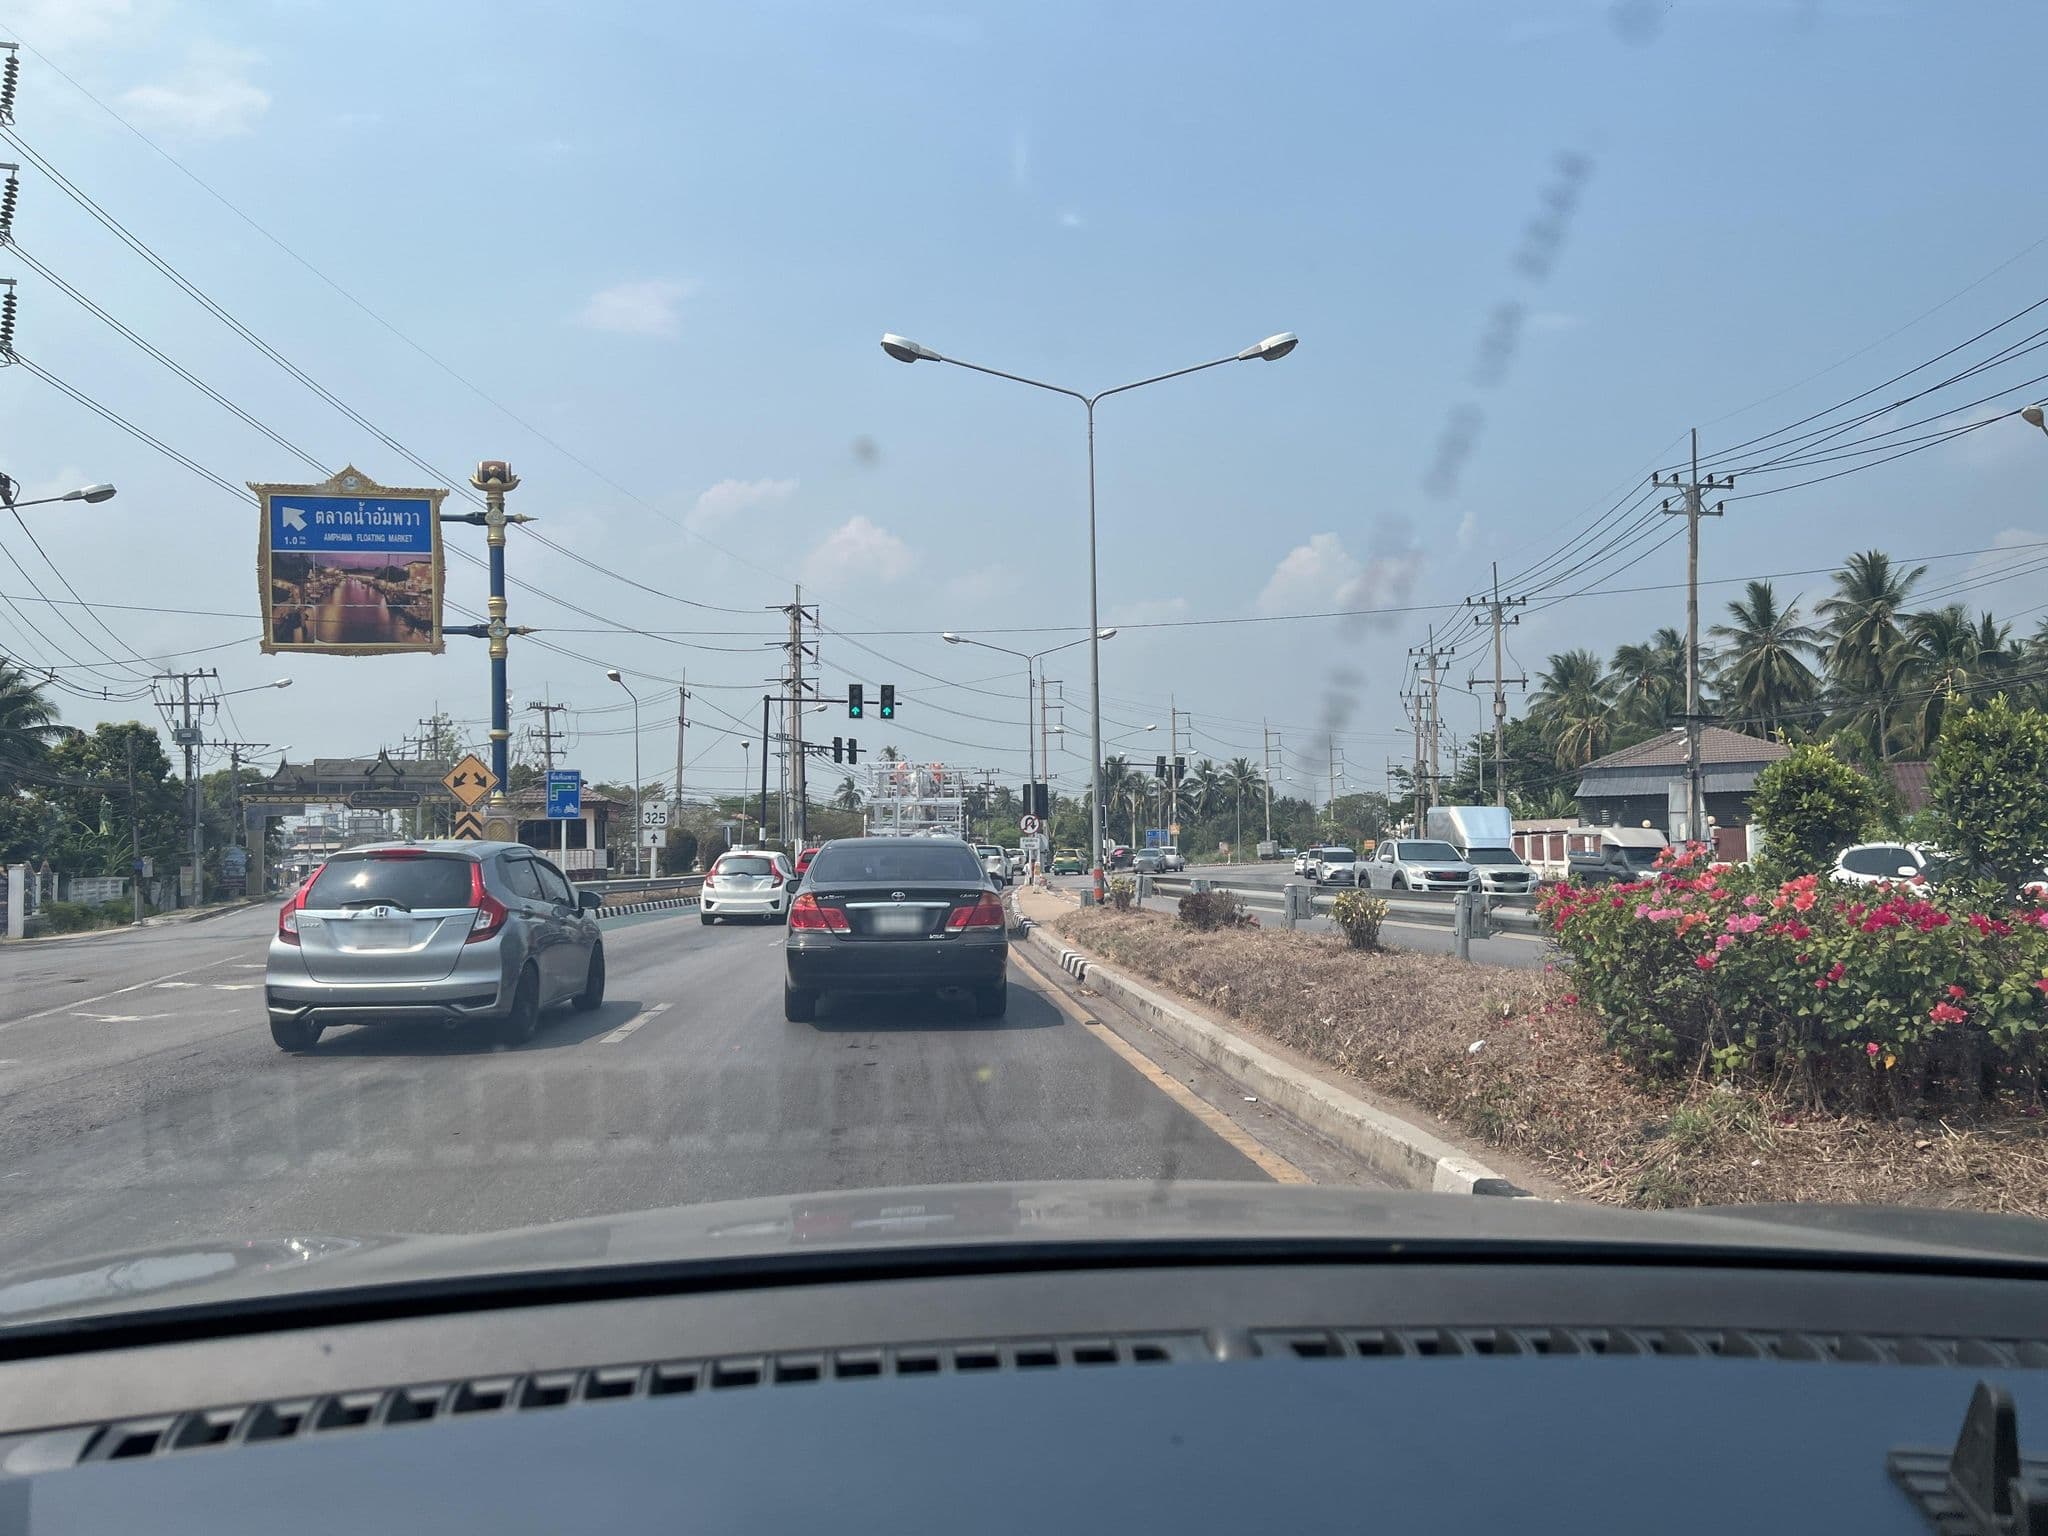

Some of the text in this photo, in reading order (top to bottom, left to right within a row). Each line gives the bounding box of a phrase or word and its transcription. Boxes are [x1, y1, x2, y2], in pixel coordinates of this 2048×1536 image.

[315, 502, 420, 526] ตลาดน้ำอัมพวา
[284, 536, 298, 545] 1.0
[324, 533, 413, 543] AMPHAWA FLOATING MARKET
[644, 812, 666, 824] 325
